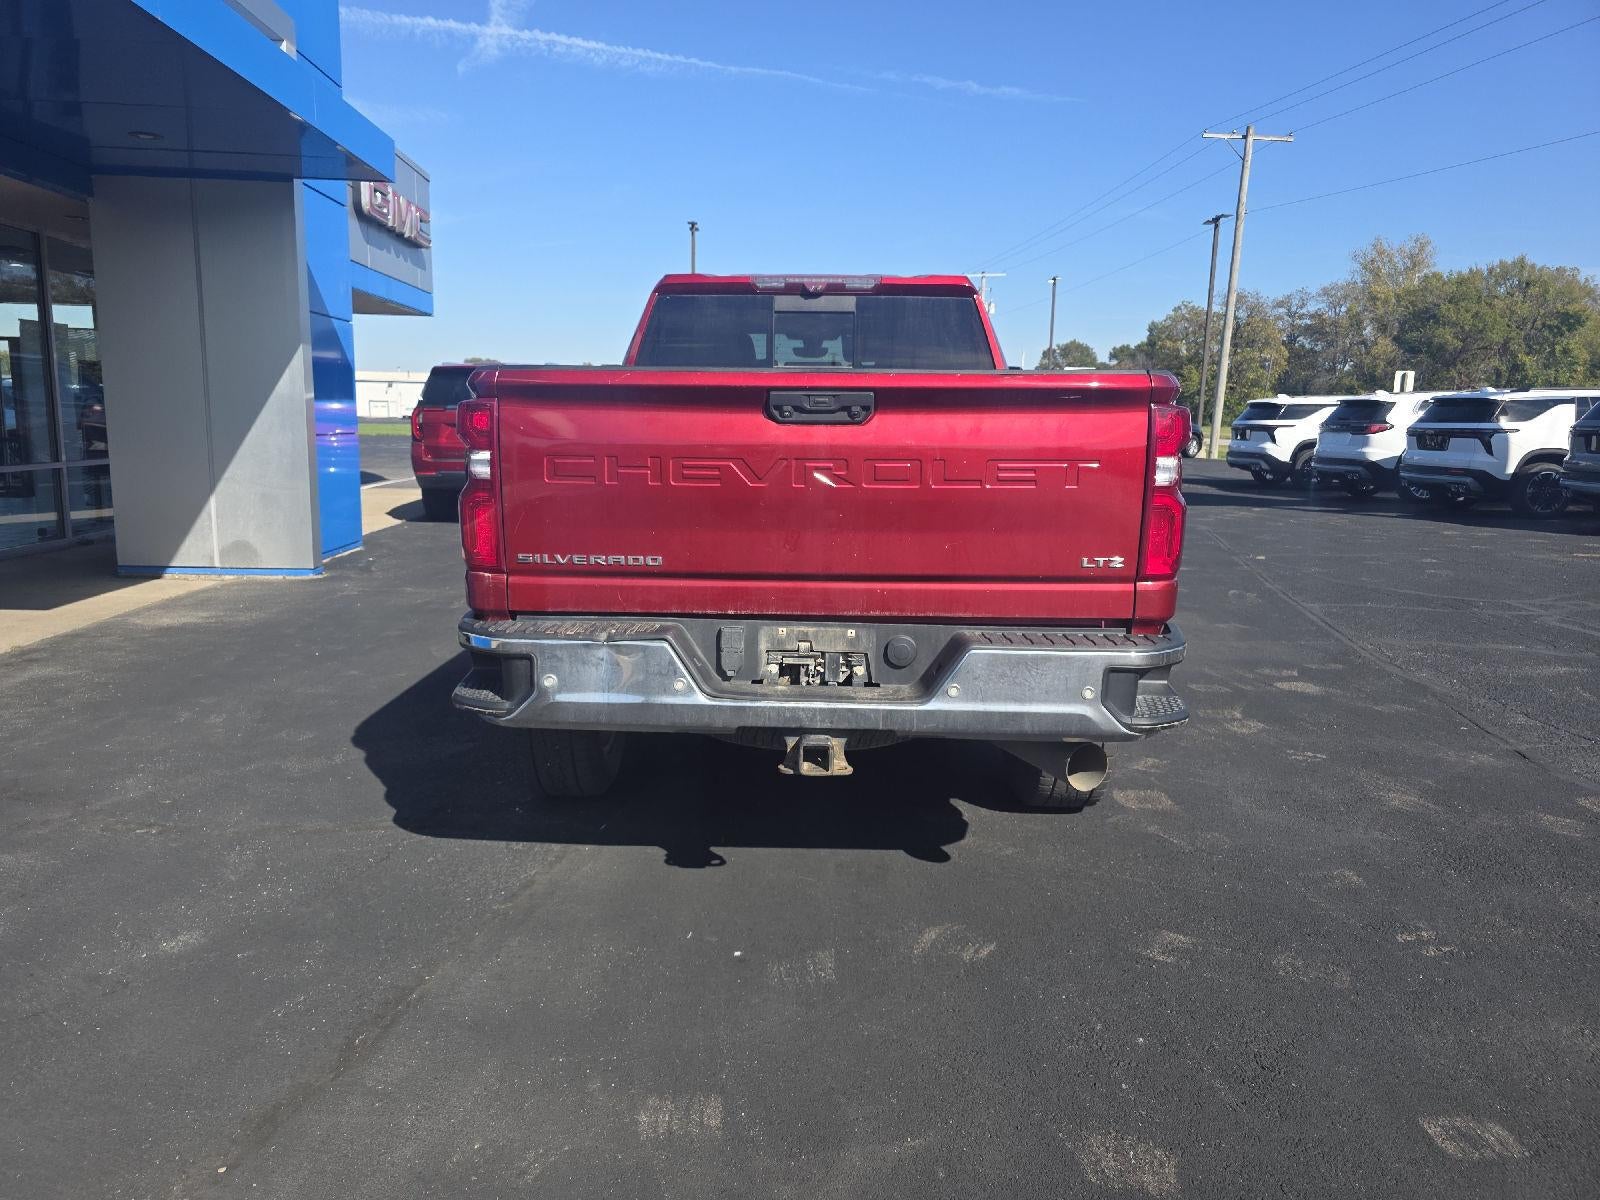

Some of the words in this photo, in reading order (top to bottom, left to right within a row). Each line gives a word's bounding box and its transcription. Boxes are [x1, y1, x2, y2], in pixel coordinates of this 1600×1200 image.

[359, 181, 432, 247] GMC
[543, 455, 1101, 488] CHEVROLET
[516, 553, 663, 566] SILVERADO
[1081, 556, 1125, 568] LTZ
